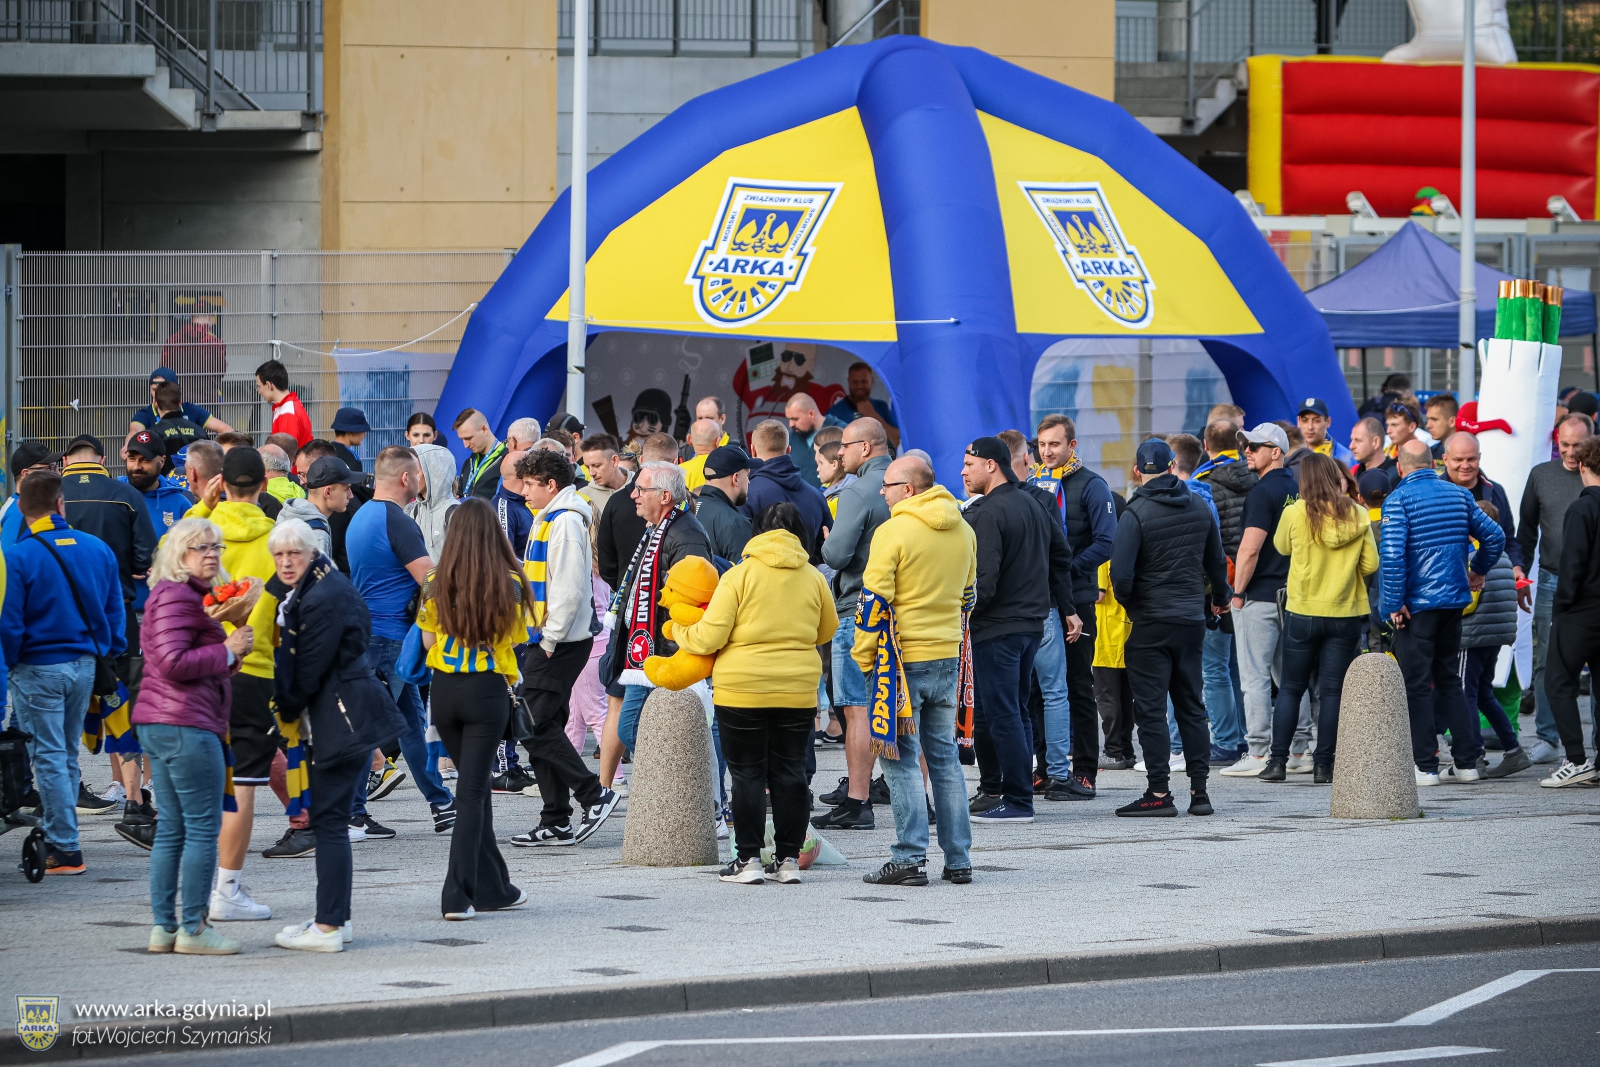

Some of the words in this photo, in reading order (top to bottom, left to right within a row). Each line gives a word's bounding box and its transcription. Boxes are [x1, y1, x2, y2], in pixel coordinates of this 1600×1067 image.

[743, 194, 792, 204] ZWIĄZKOWY
[793, 196, 814, 204] KLUB
[722, 210, 738, 242] MORSKI
[789, 208, 816, 251] SPORTOWY
[711, 258, 784, 275] ARKA
[1080, 259, 1134, 275] ARKA
